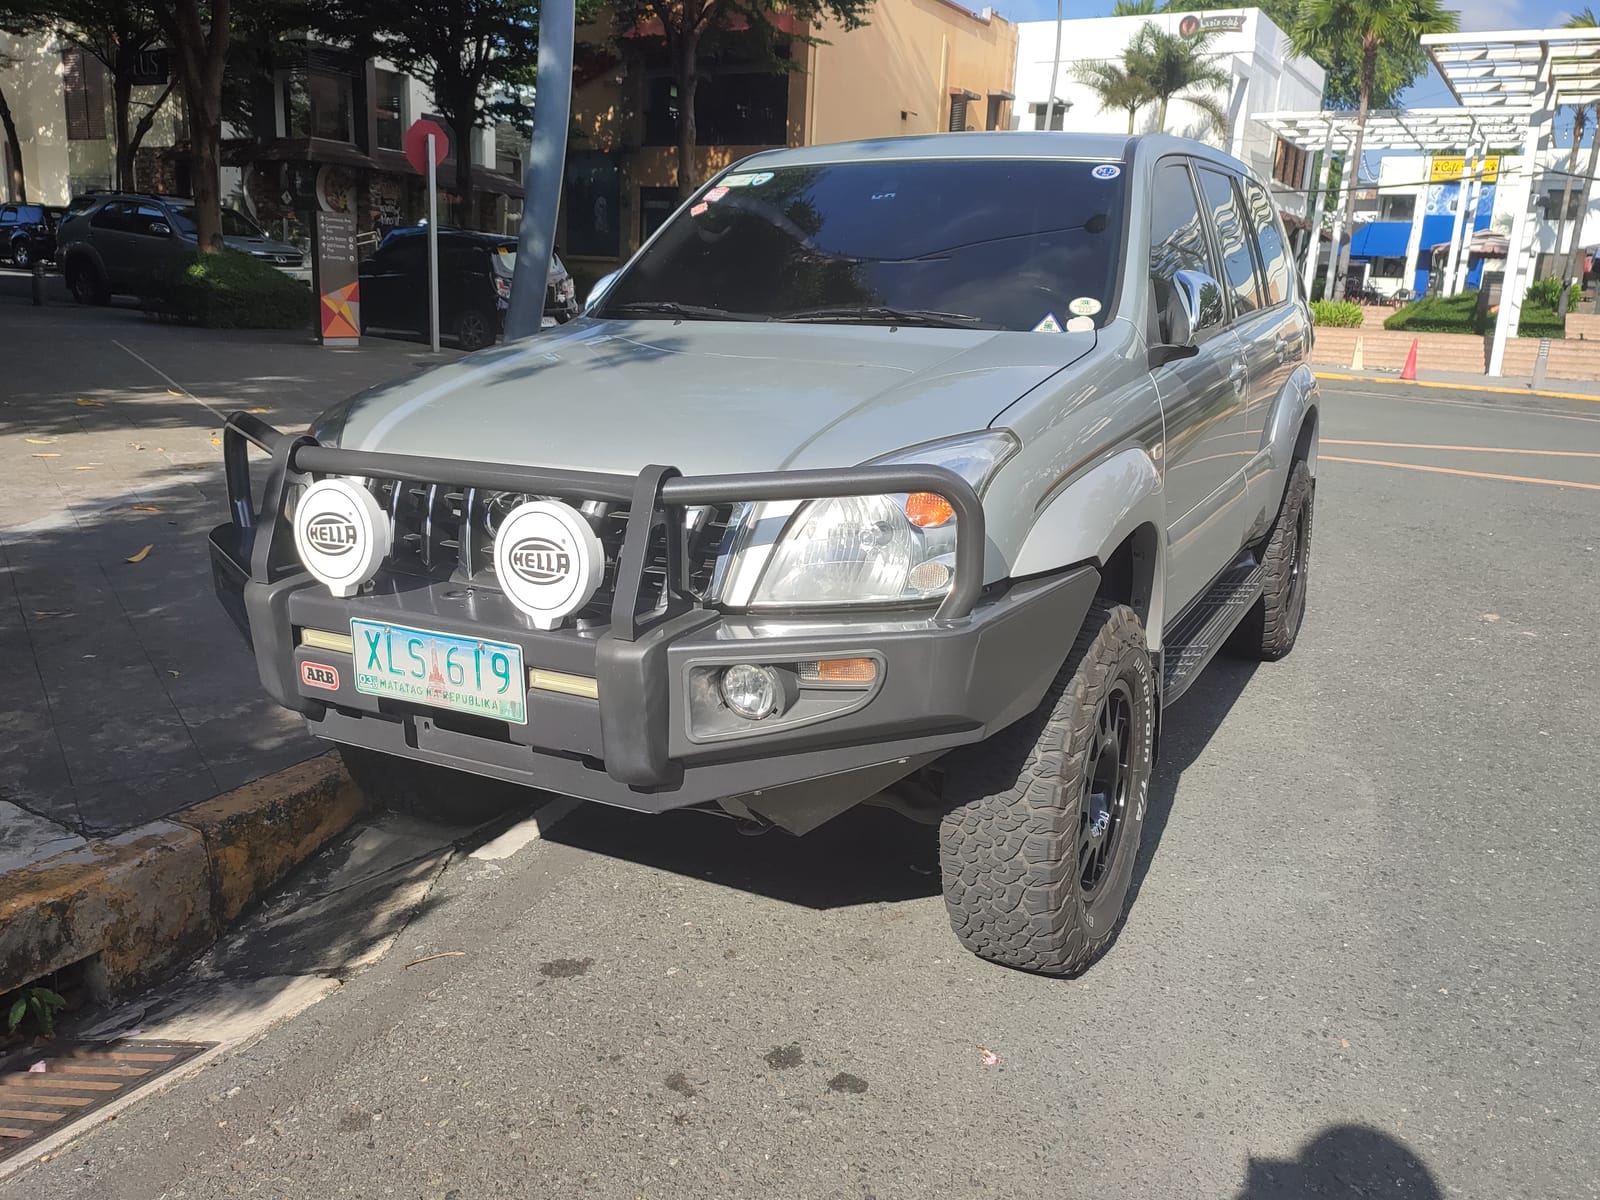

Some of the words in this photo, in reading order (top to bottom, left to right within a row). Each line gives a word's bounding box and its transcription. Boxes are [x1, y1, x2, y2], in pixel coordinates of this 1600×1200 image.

[310, 524, 357, 545] HELLA
[513, 552, 570, 574] HELLA
[365, 630, 426, 679] XLS
[446, 646, 511, 694] 619
[307, 667, 335, 684] ARB
[379, 679, 423, 695] MATATAG
[442, 690, 498, 710] REPUBLIKA
